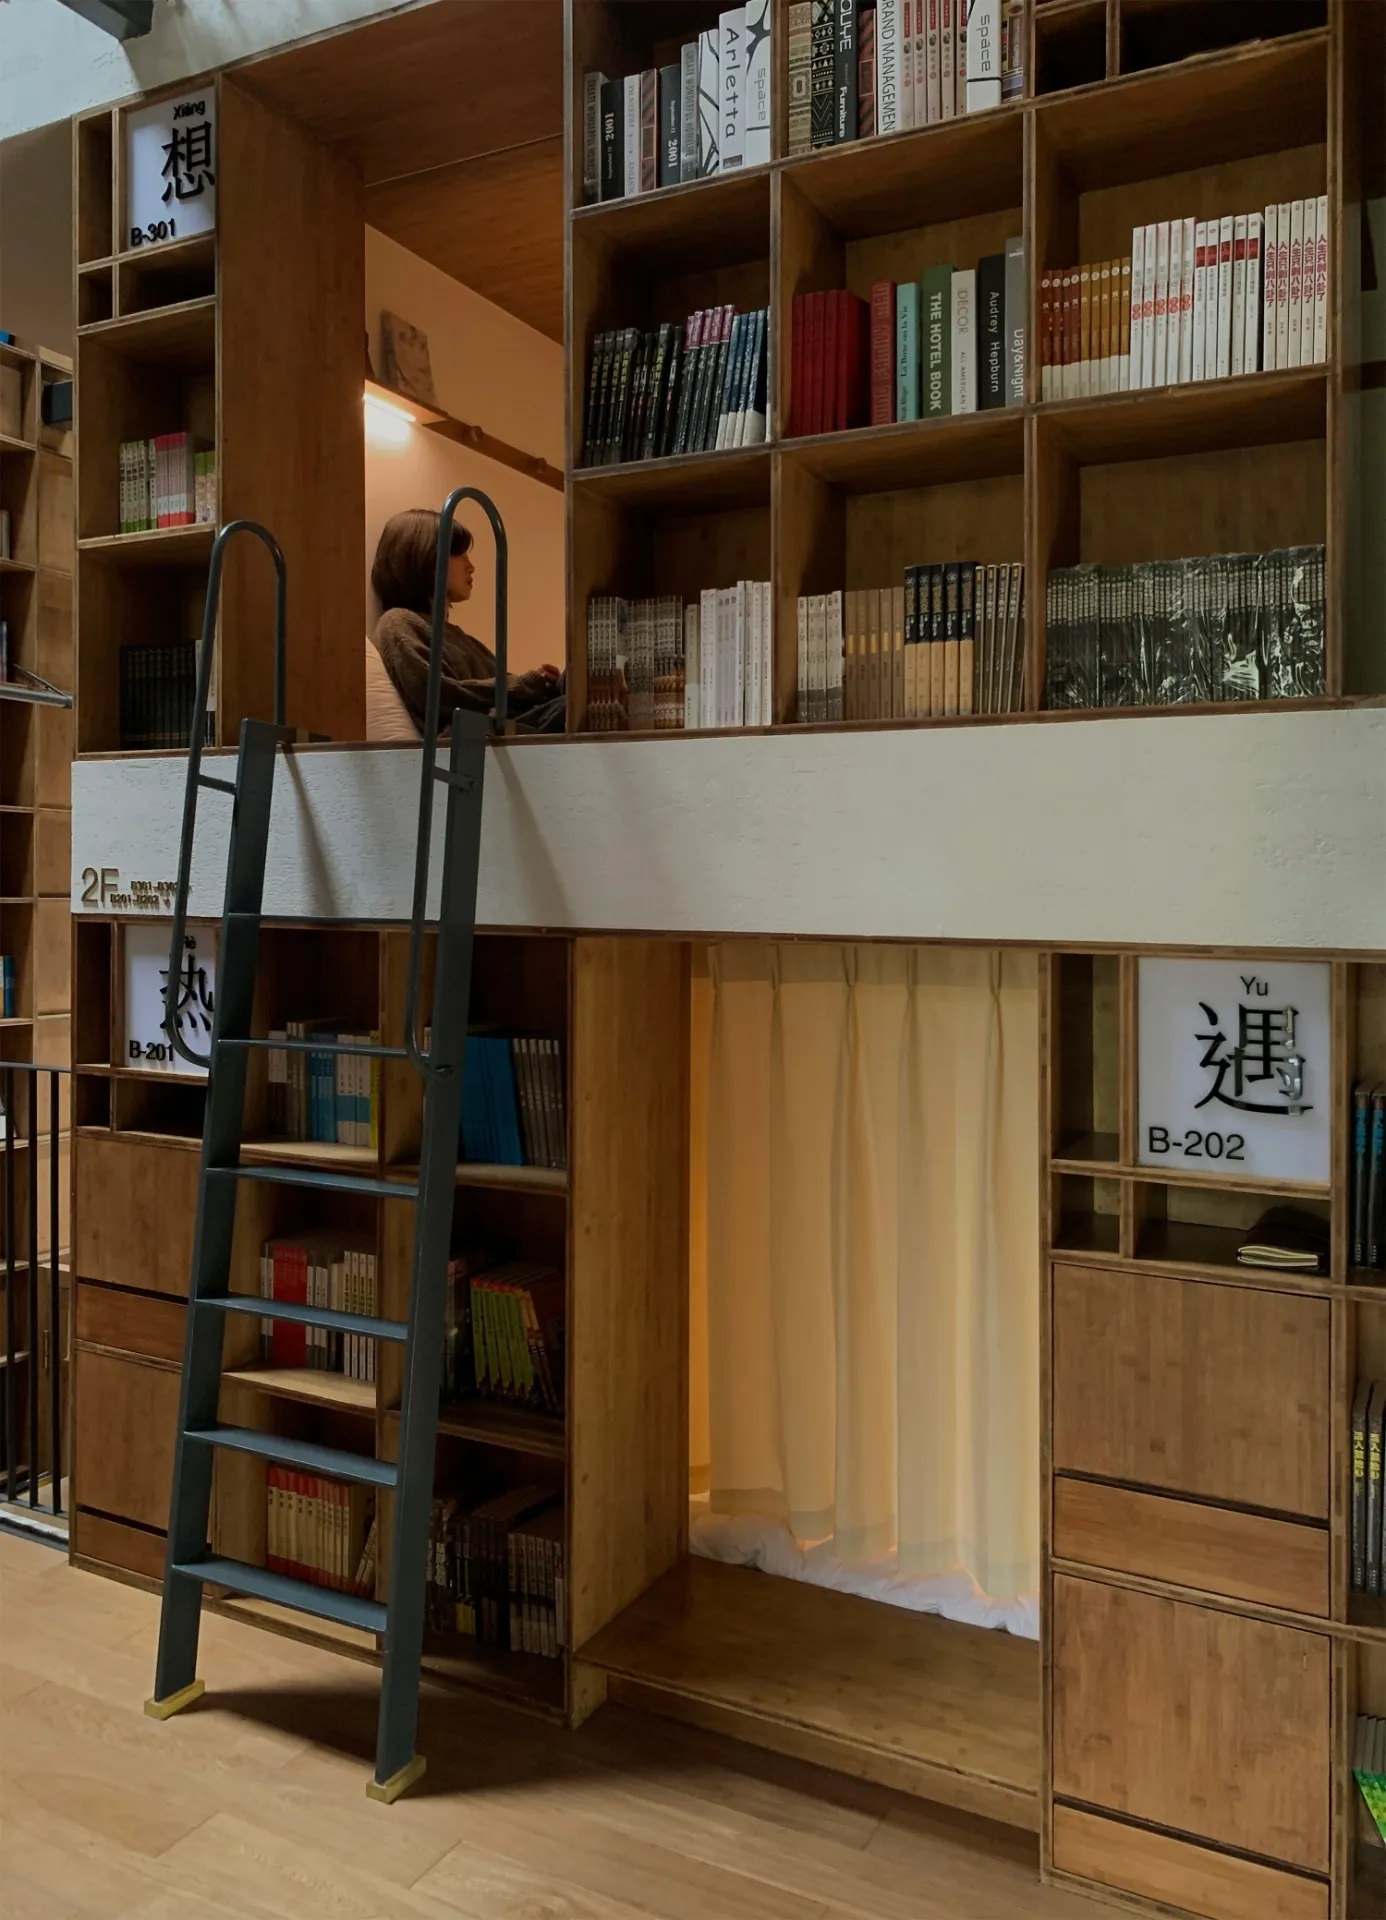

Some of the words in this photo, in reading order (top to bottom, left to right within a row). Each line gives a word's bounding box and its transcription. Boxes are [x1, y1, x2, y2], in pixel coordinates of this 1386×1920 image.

[976, 14, 991, 73] space
[685, 78, 696, 121] WONDERFUL
[724, 27, 740, 139] Arletta
[754, 68, 767, 121] space
[882, 42, 896, 133] MANAGEMEN
[586, 105, 597, 147] WONDERFUL
[604, 112, 615, 142] 2001
[838, 86, 848, 138] Furniture
[161, 121, 215, 202] 想
[667, 138, 678, 168] 2001
[130, 218, 177, 247] B-301
[930, 292, 942, 321] THE
[957, 287, 968, 335] DECOR
[988, 291, 1000, 333] Audrey
[930, 322, 942, 369] HOTEL
[900, 365, 908, 378] La
[988, 341, 1000, 393] Hepburn
[929, 371, 942, 411] BOOK
[81, 867, 119, 903] 2F
[1239, 976, 1269, 996] Yu
[129, 1040, 174, 1062] B-201
[1194, 1001, 1314, 1115] 遇
[1148, 1126, 1246, 1161] B-202
